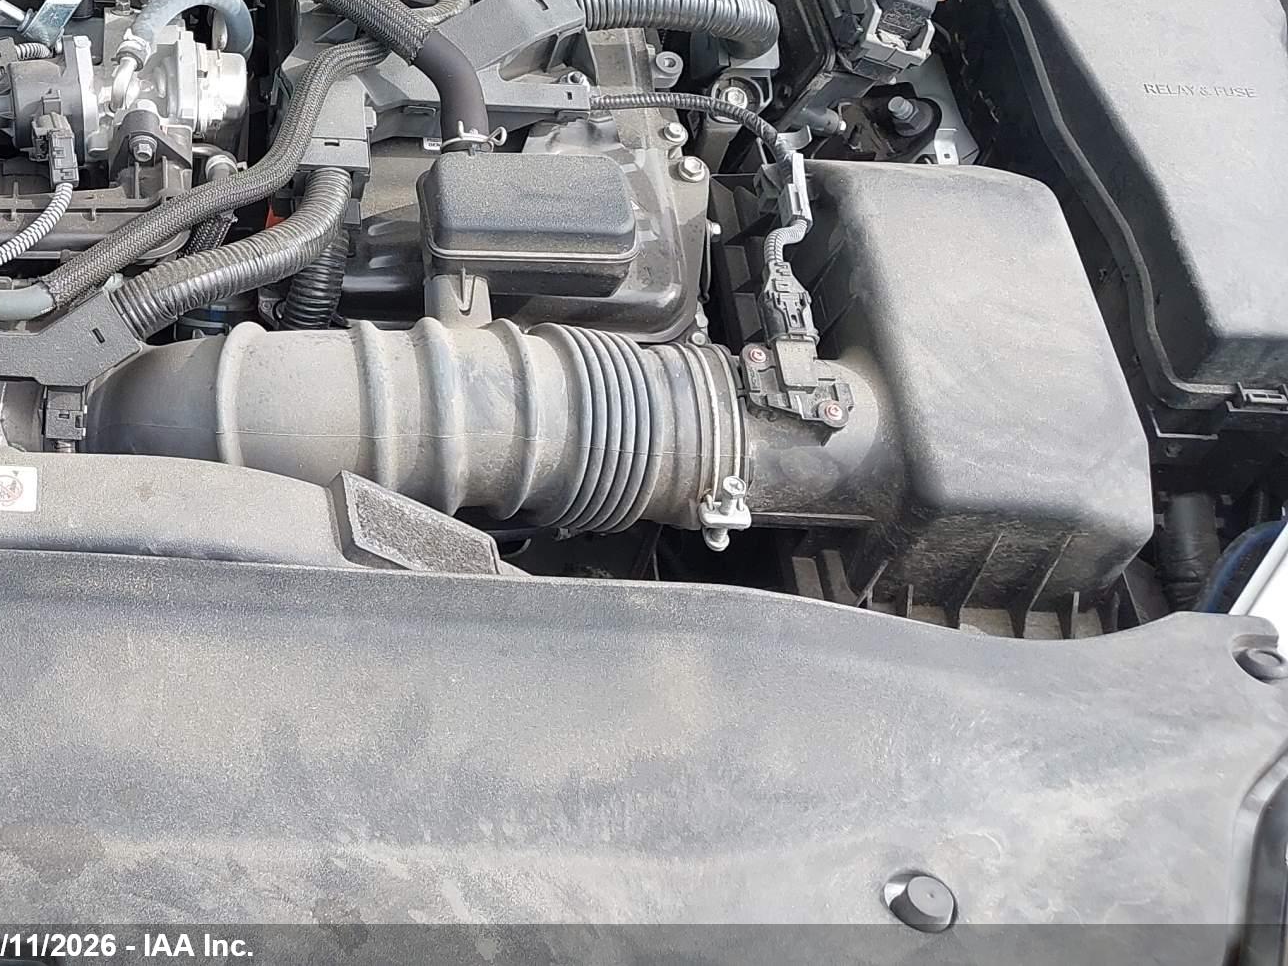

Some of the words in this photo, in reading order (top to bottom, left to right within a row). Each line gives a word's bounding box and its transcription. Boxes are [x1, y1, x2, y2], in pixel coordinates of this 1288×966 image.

[1143, 83, 1195, 96] RELAY
[1199, 86, 1211, 96] &
[1214, 86, 1258, 98] FUSE
